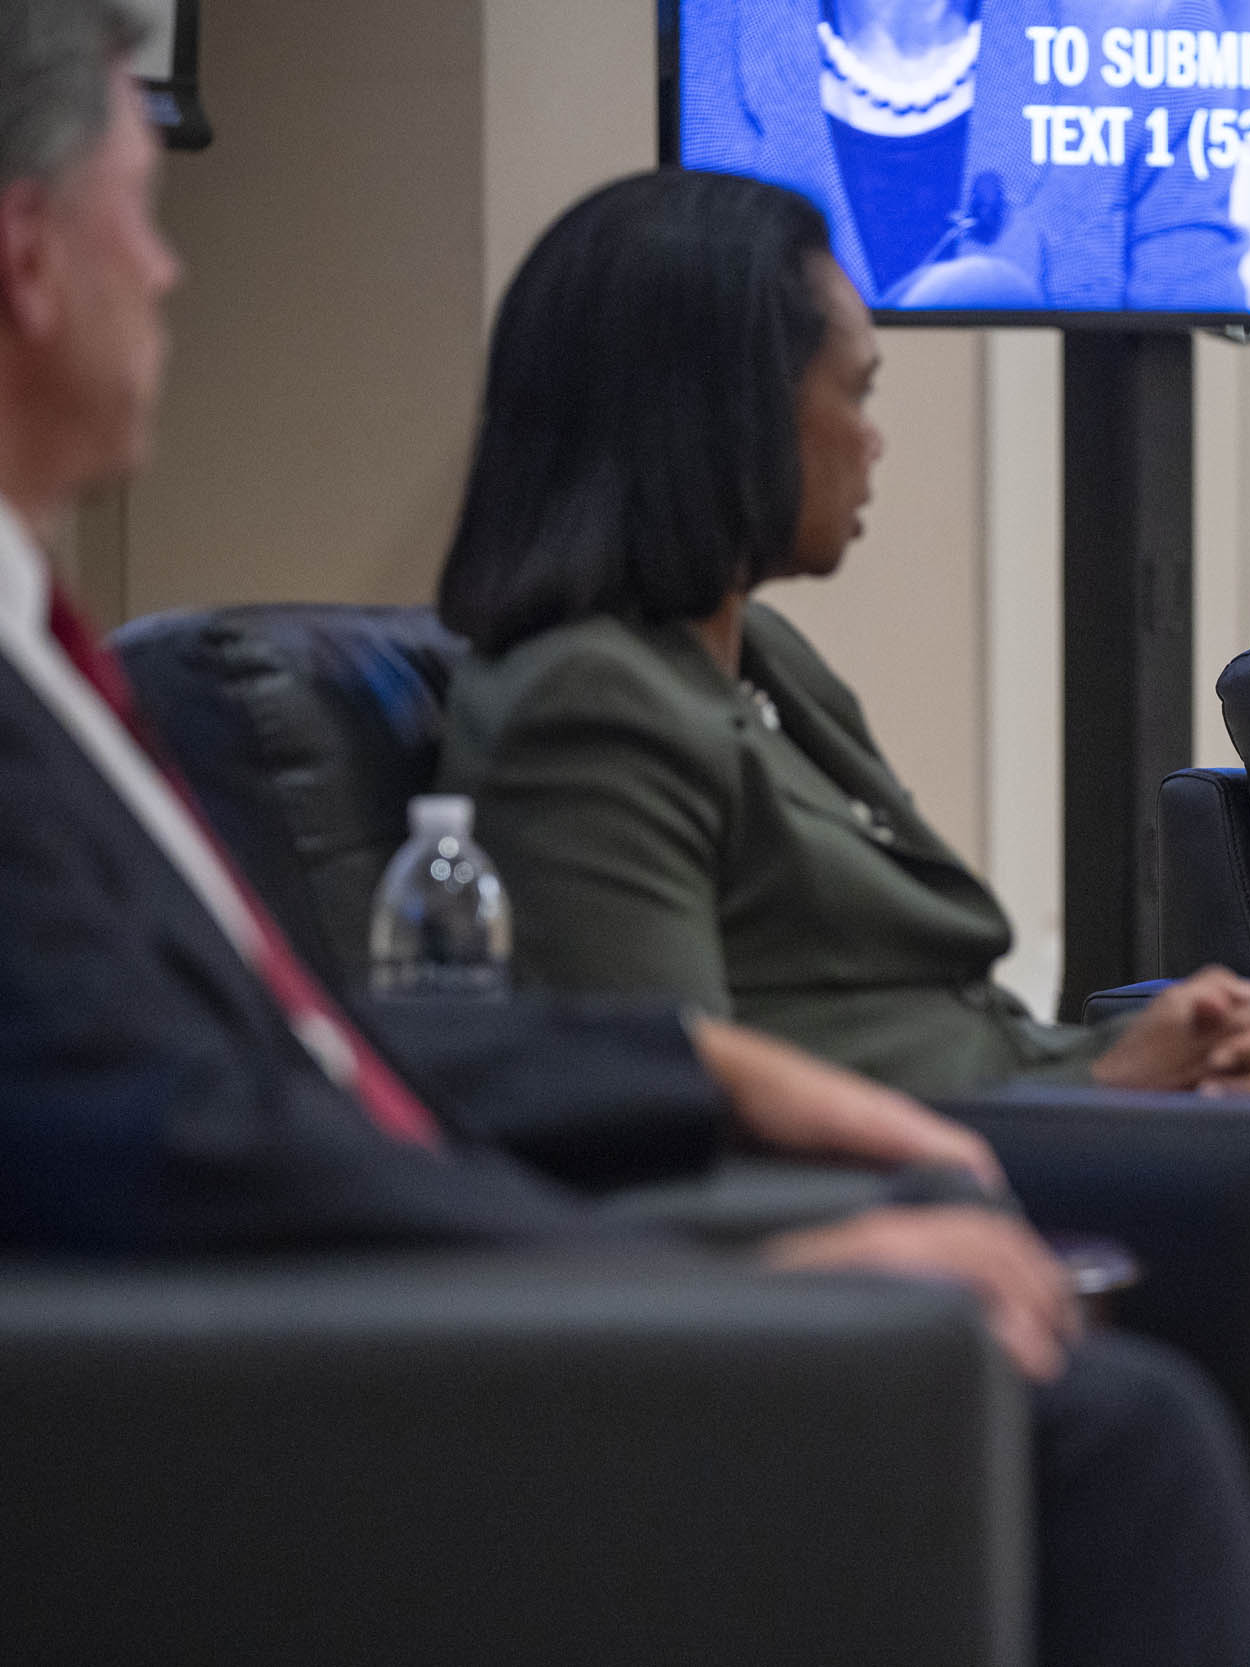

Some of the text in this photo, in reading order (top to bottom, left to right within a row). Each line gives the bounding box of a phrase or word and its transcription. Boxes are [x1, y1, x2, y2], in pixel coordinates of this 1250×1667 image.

[1026, 27, 1087, 85] TO
[1023, 106, 1131, 165] TEXT
[1146, 108, 1175, 167] 1
